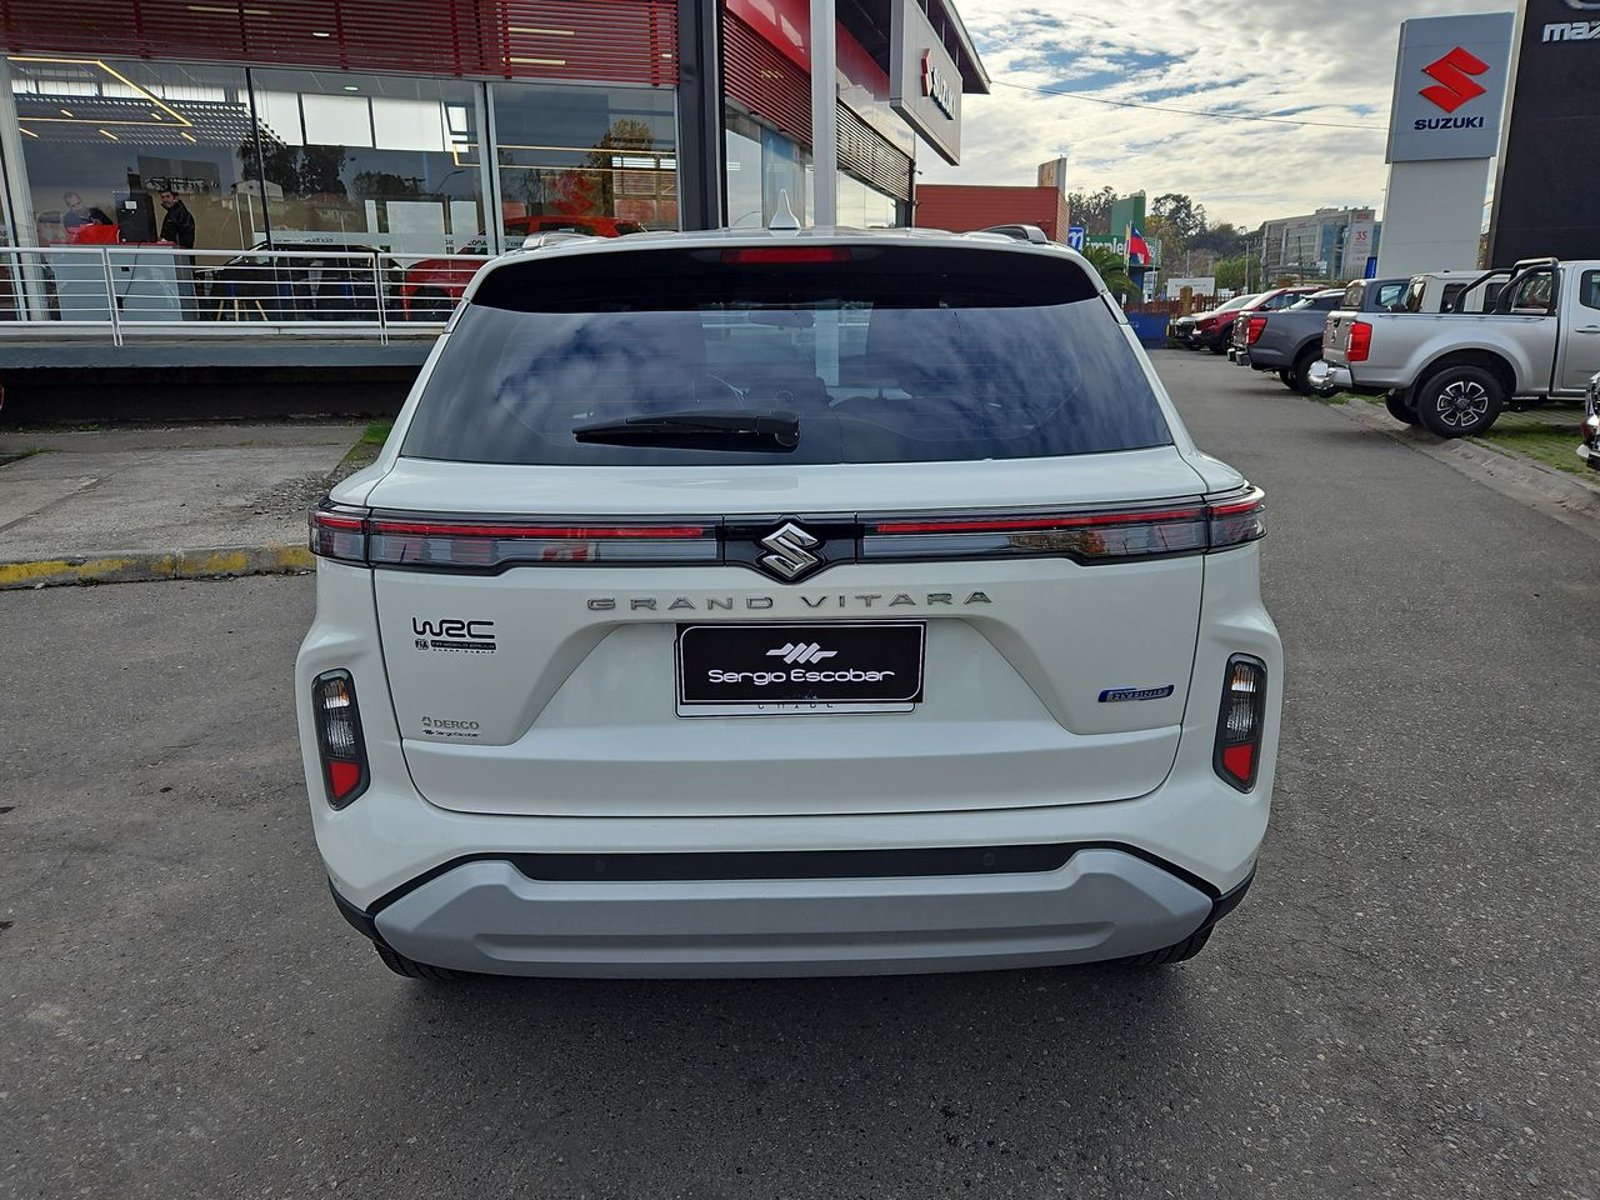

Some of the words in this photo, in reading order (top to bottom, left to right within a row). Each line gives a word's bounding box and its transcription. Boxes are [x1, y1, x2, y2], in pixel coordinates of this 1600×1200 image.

[1414, 116, 1485, 130] SUZUKI
[586, 595, 775, 611] GRAND
[801, 590, 993, 608] VITARA
[412, 616, 496, 640] WRC
[708, 669, 787, 686] Sergio
[790, 668, 896, 683] Escobar
[433, 719, 480, 730] DERCO
